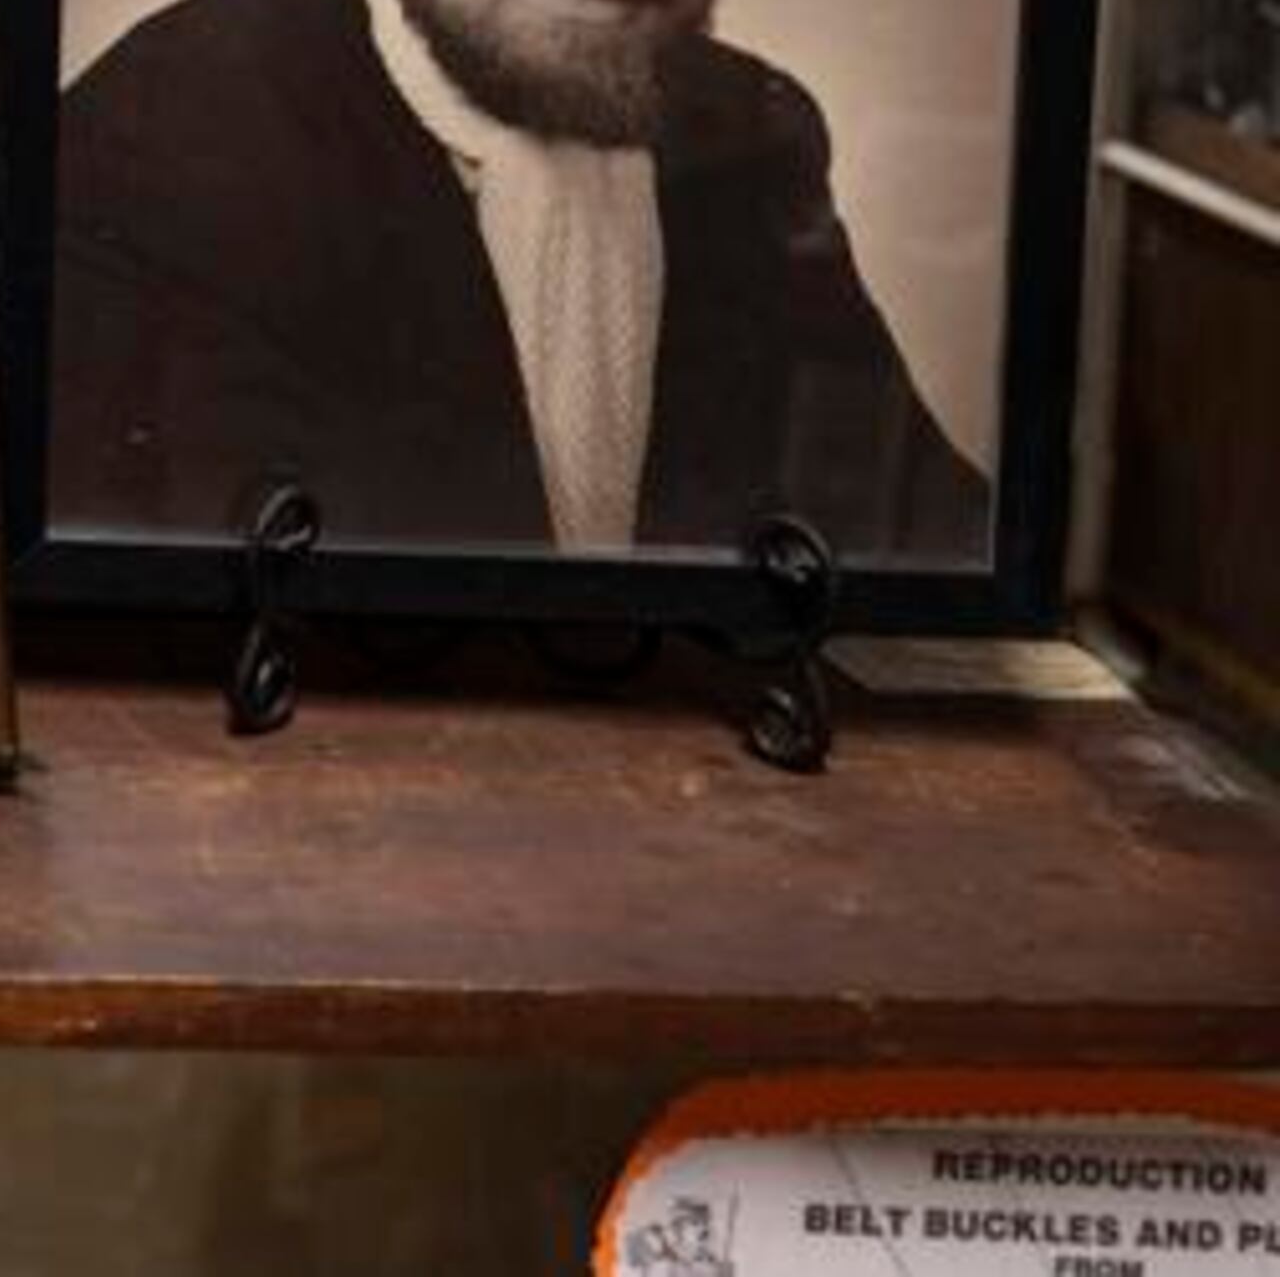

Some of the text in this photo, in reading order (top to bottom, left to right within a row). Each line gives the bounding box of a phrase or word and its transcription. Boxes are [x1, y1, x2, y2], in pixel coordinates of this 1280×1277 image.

[930, 1149, 1267, 1196] REPRODUCTION
[803, 1203, 910, 1239] BELT
[924, 1207, 1120, 1246] BUCKLES
[1136, 1217, 1223, 1253] AND
[1053, 1255, 1144, 1277] FROM
